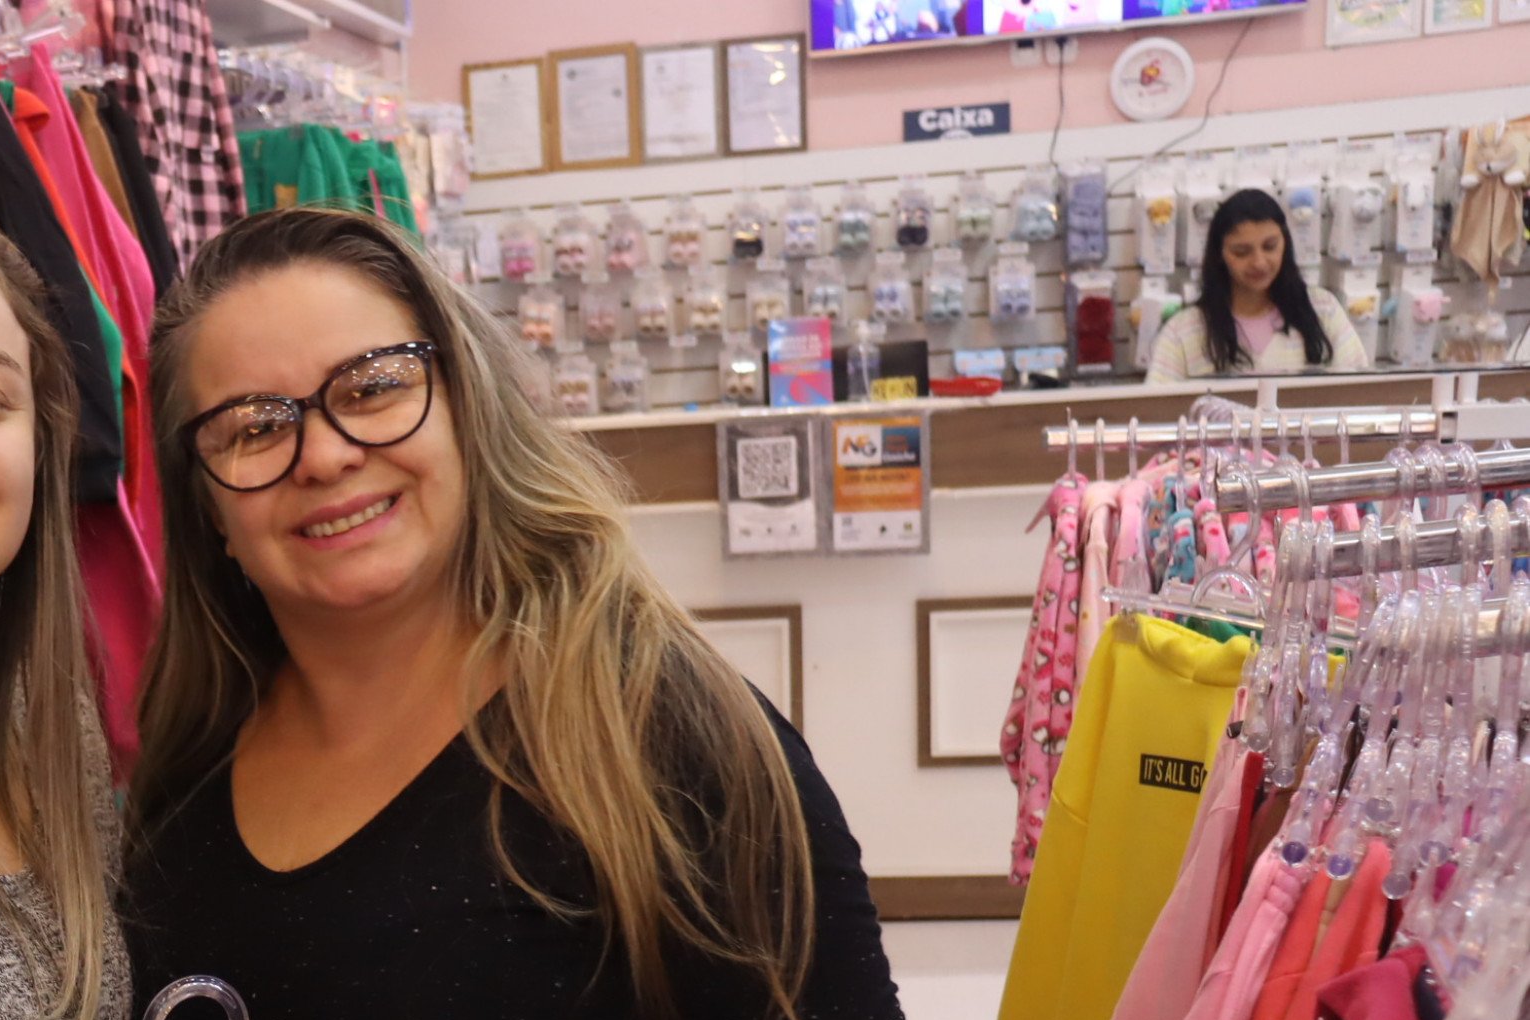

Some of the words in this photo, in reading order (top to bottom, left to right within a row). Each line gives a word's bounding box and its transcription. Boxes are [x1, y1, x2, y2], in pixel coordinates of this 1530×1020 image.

[918, 106, 995, 132] Caixa
[1143, 757, 1163, 783] IT'S
[1164, 761, 1186, 786] ALL
